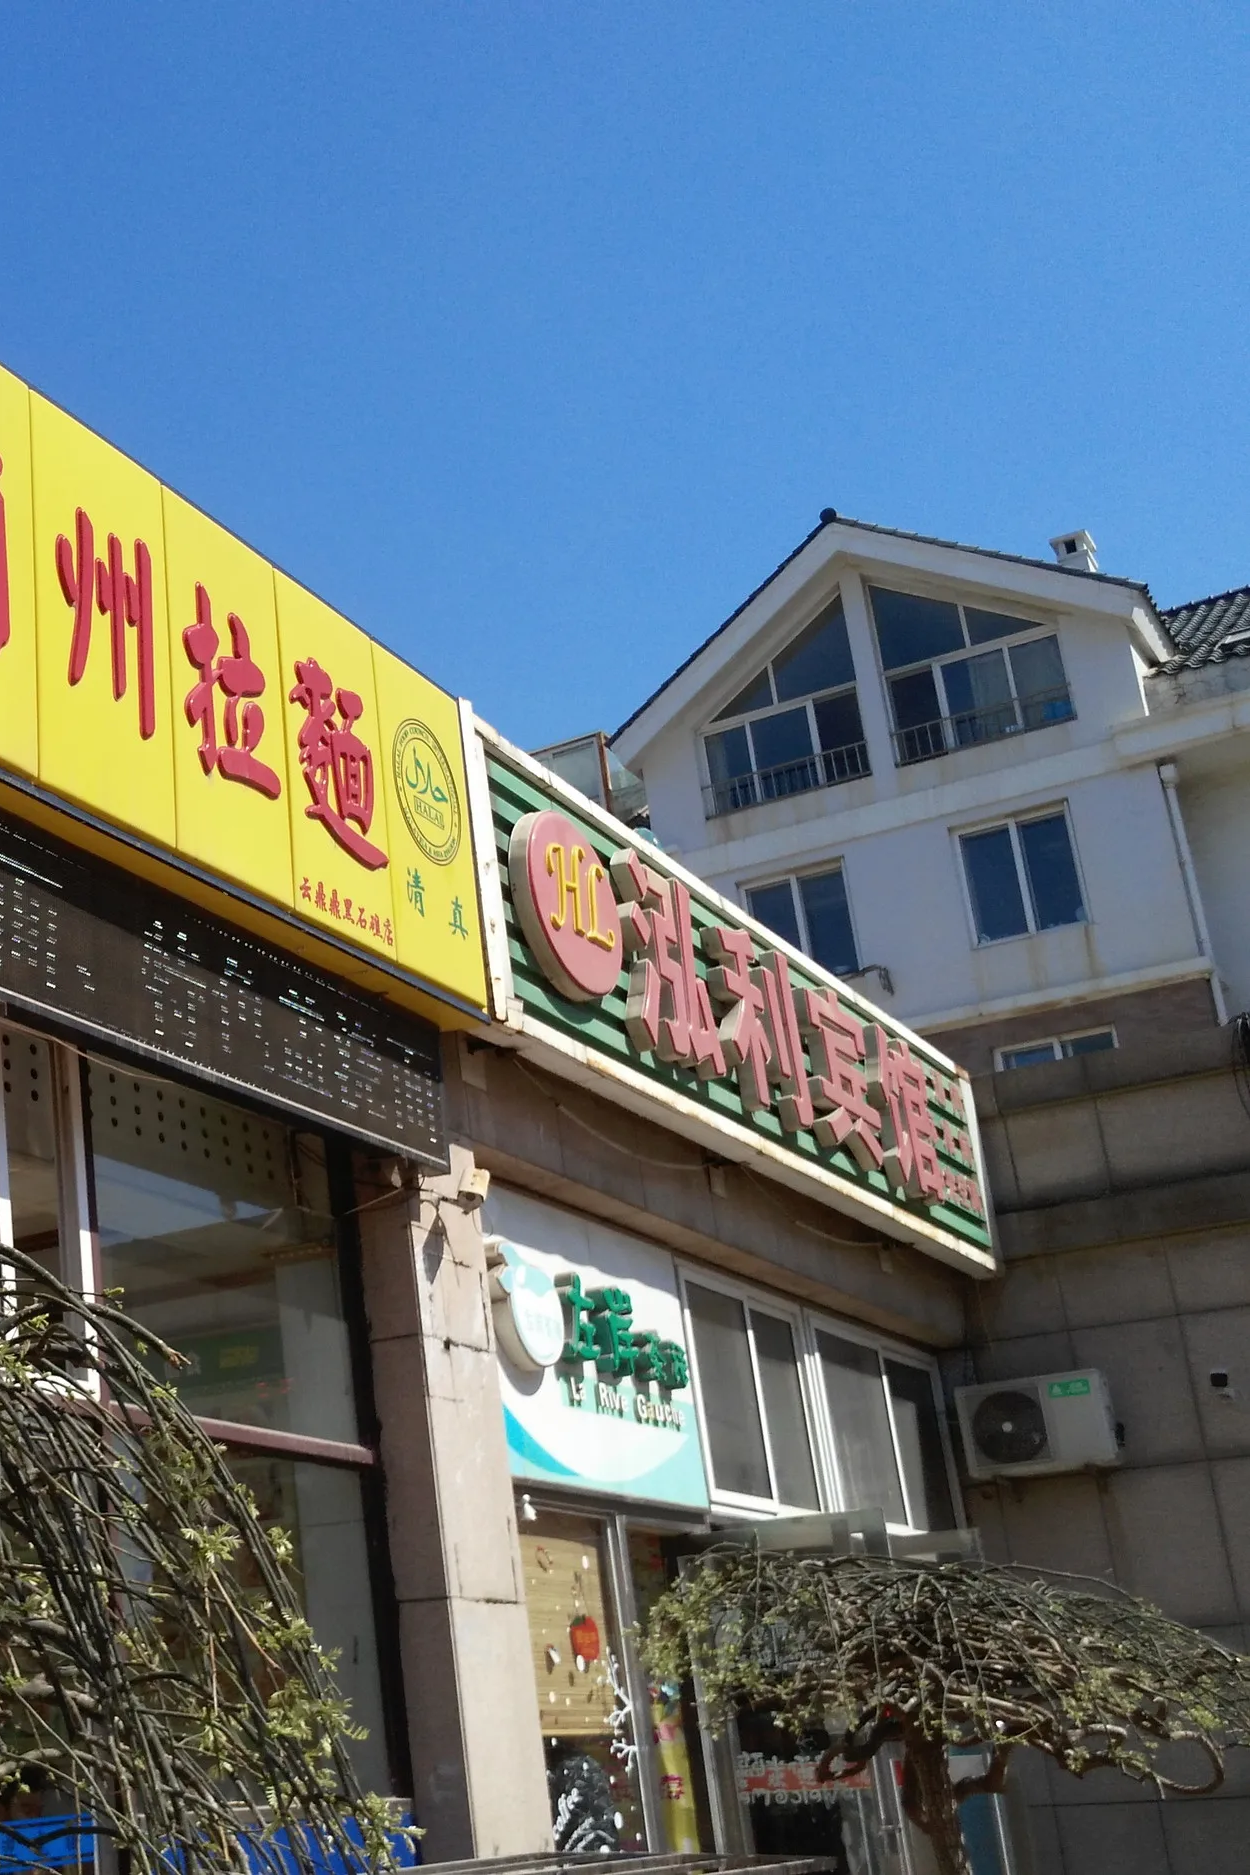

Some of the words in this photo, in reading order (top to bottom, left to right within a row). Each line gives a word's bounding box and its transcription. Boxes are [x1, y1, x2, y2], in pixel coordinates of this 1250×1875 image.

[612, 847, 944, 1205] 泓利宾馆
[570, 1376, 586, 1402] La
[598, 1382, 630, 1413] Rive
